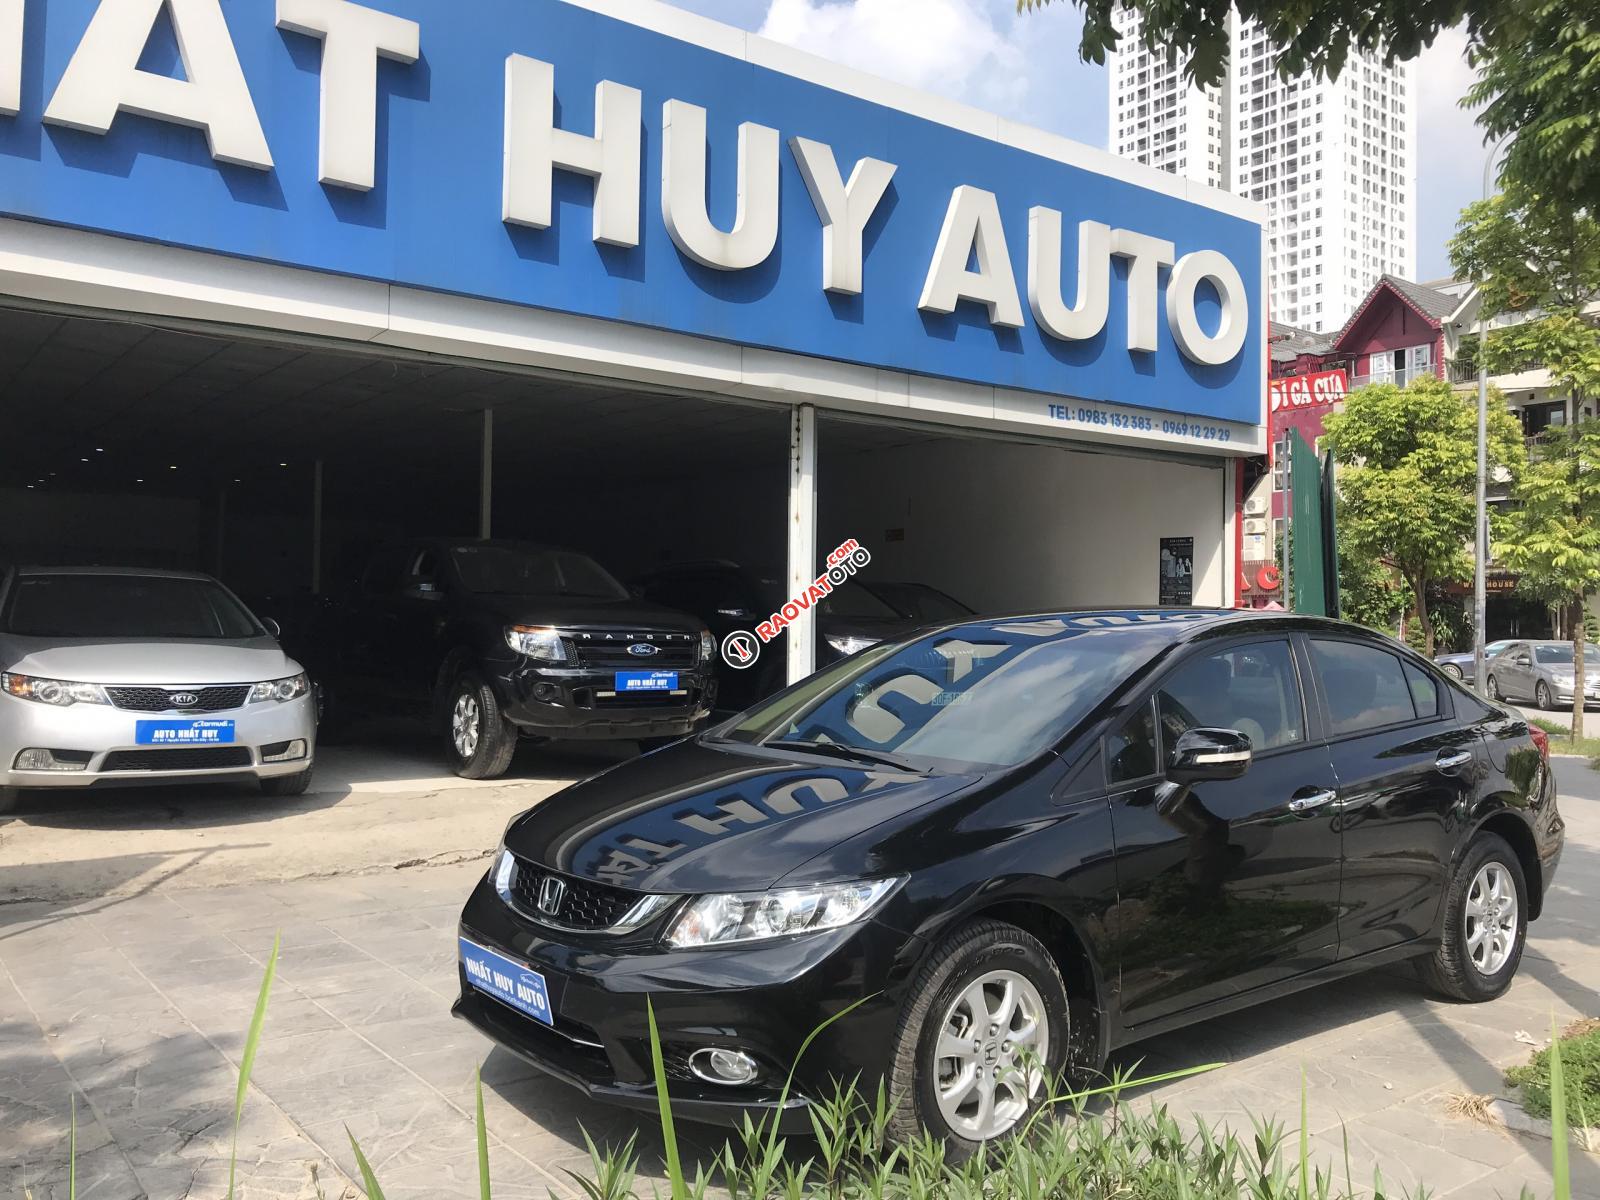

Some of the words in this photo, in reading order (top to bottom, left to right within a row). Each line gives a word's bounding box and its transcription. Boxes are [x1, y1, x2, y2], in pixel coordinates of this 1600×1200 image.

[501, 52, 898, 295] HUY
[917, 184, 1249, 365] AUTO
[1048, 404, 1075, 421] TEL:
[1077, 408, 1108, 426] 0983
[1162, 420, 1188, 436] 0969
[175, 695, 193, 703] KIA
[153, 729, 176, 738] AUTO
[201, 729, 218, 738] HUY
[493, 970, 514, 995] HUY
[517, 983, 546, 1011] AUTO
